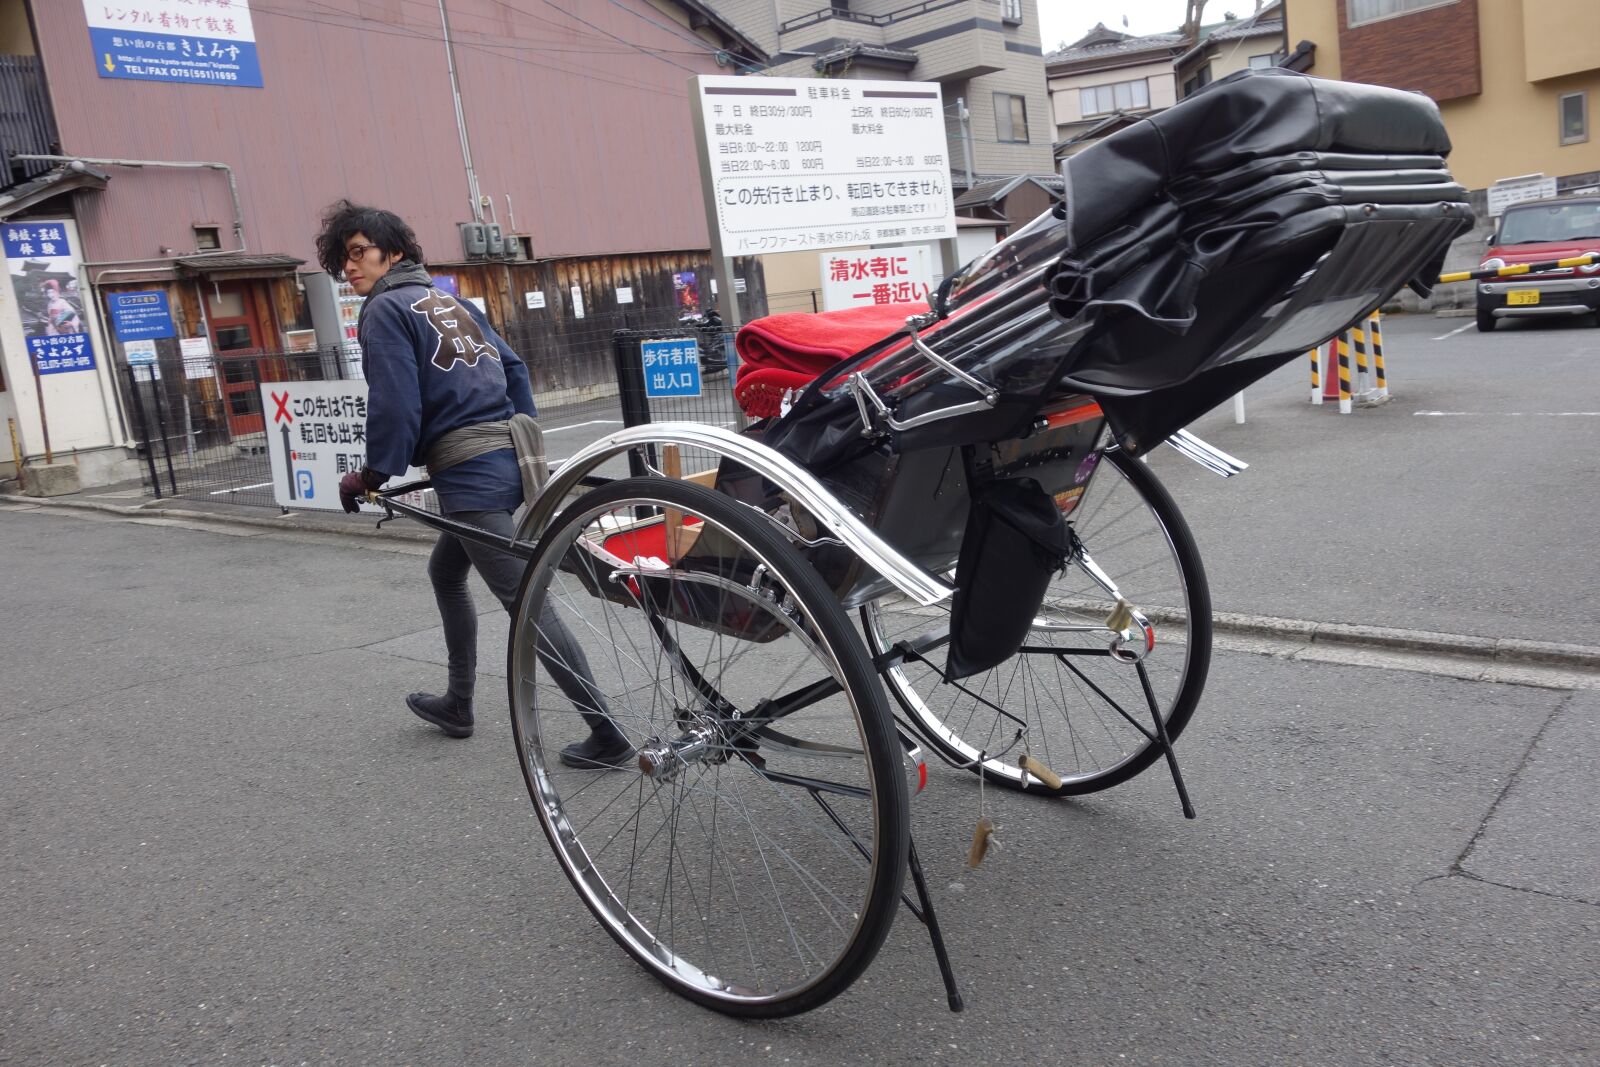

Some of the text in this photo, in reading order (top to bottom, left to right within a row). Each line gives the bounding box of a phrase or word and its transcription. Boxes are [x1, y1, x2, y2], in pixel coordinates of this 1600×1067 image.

[104, 6, 237, 34] レンタル着物で散策
[181, 39, 240, 61] きよみず
[124, 65, 169, 76] TEL/FAX
[808, 86, 851, 100] 駐車料金
[715, 123, 754, 135] 最大料金
[852, 123, 884, 135] 最大料金
[723, 179, 943, 206] この先行き止まり、転回もできません
[830, 257, 908, 282] 清水寺に
[853, 282, 929, 305] 一番近い
[36, 344, 84, 359] きよみず
[645, 347, 698, 367] 歩行者用
[653, 373, 692, 390] 出入口
[293, 396, 367, 418] この先は行き
[300, 423, 366, 445] 転回も出来
